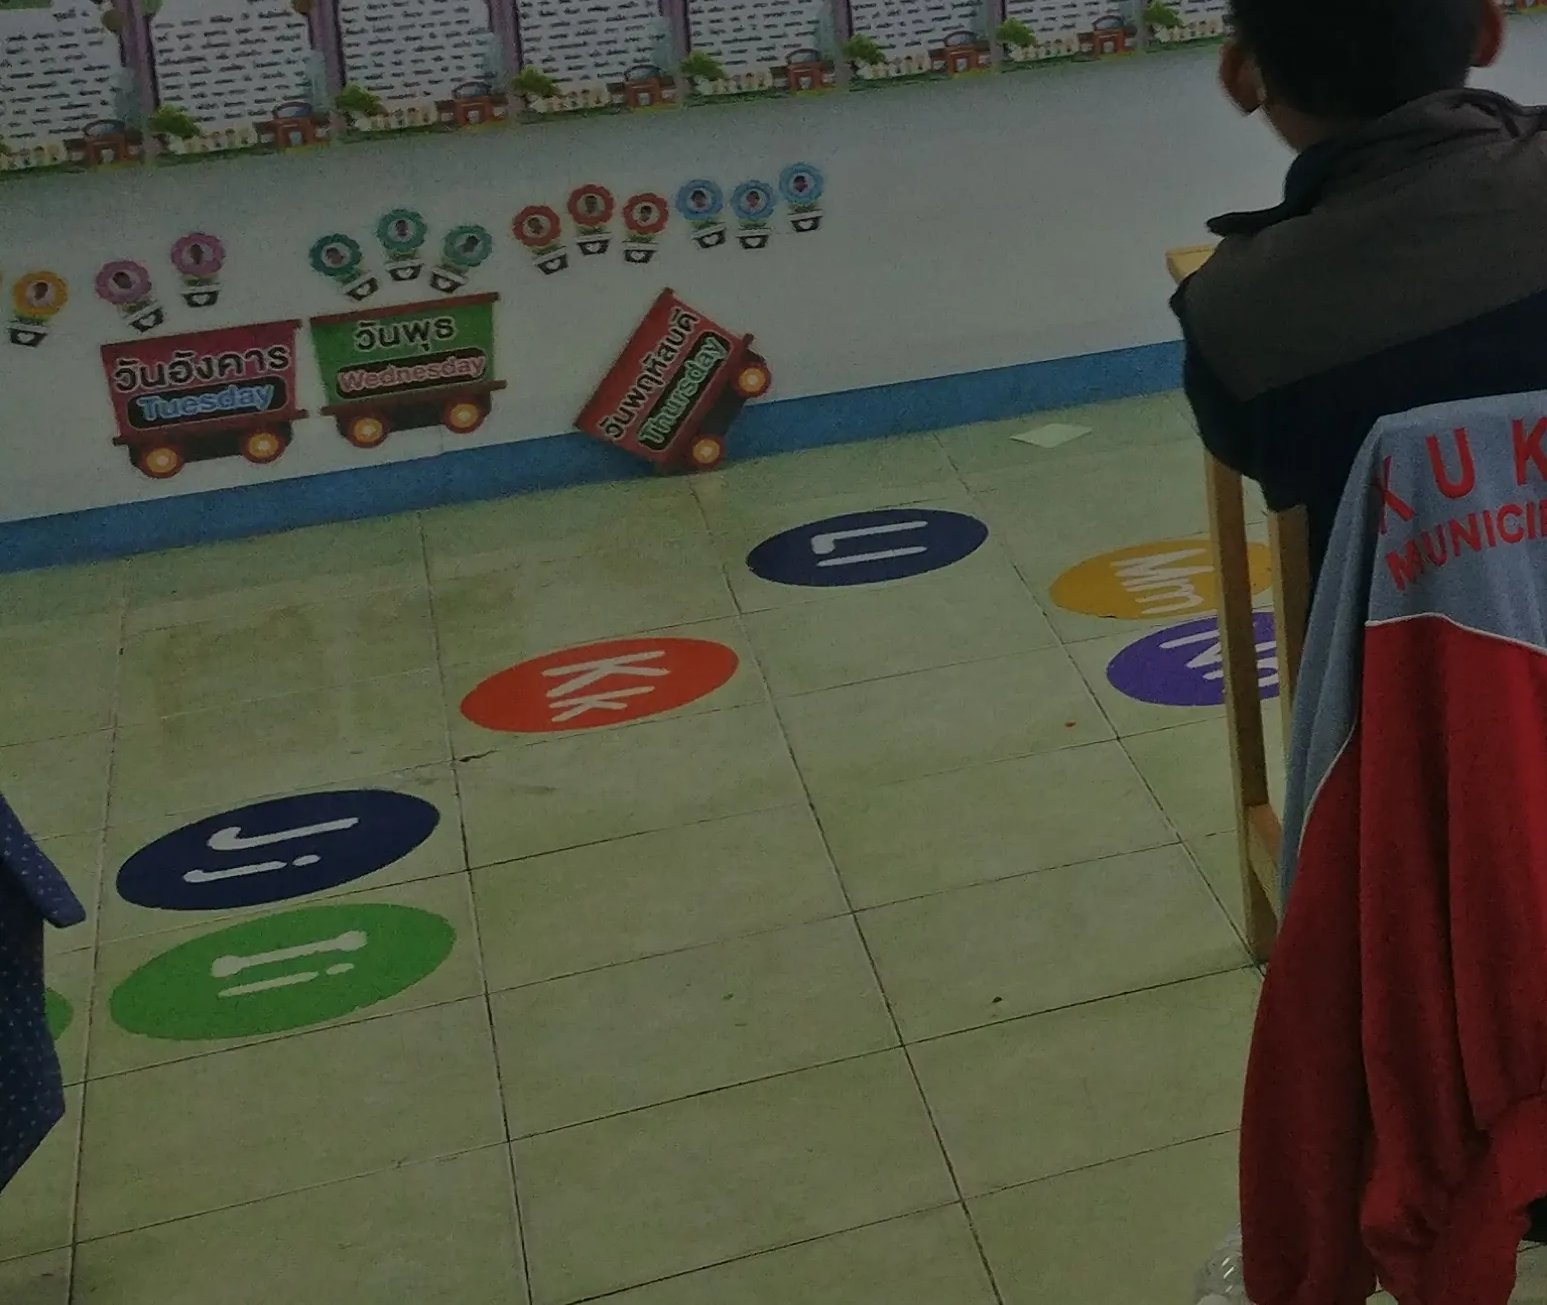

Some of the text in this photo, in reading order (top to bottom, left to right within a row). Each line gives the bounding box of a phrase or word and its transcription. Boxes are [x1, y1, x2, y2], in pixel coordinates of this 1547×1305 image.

[354, 315, 456, 352] วันพุธ
[113, 343, 291, 394] วันอังคาร
[139, 381, 275, 422] Tuesday
[337, 353, 488, 395] Wednesday
[597, 306, 698, 441] วันพฤหัสบดี
[636, 336, 729, 445] Thursday
[1109, 546, 1216, 616] Mm
[541, 649, 671, 724] Kk
[181, 816, 363, 885] Jj
